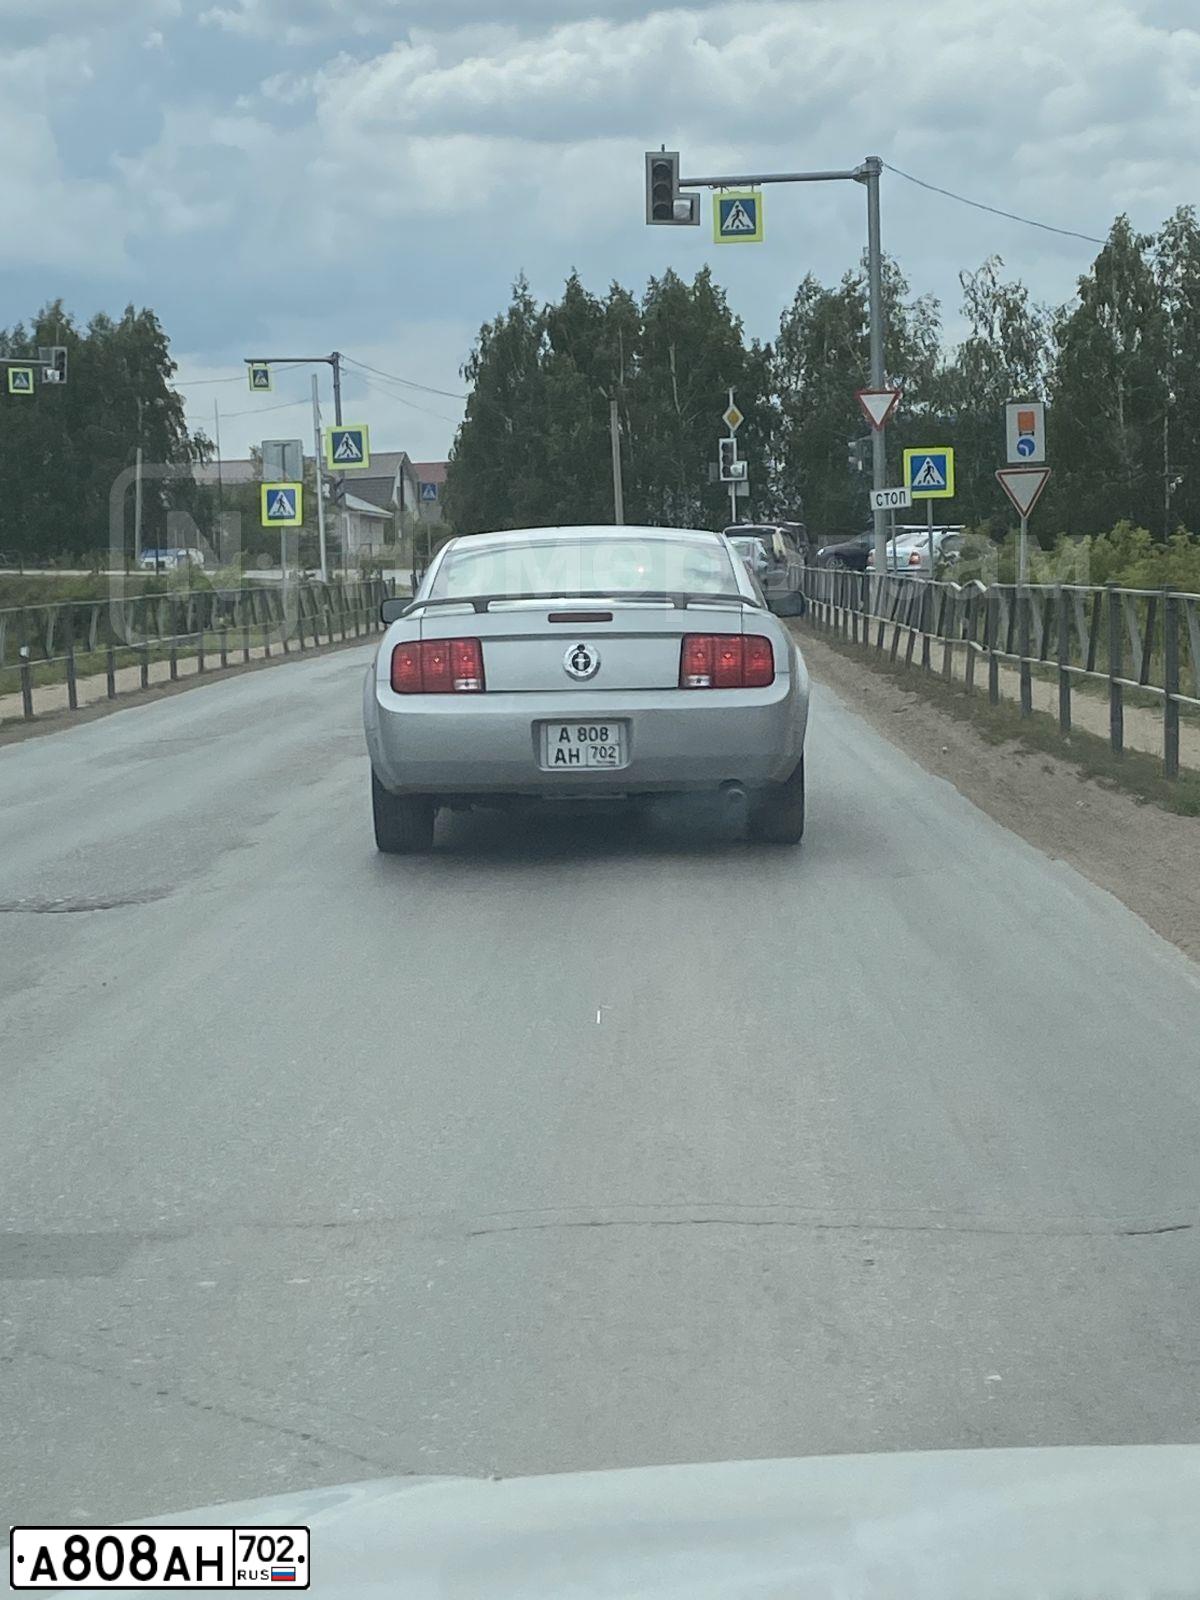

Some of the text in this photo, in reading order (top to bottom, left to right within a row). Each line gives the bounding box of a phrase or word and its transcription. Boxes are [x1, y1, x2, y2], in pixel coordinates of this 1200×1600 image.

[876, 491, 906, 507] СТОП
[558, 726, 609, 743] А 808
[554, 746, 616, 764] АН 702
